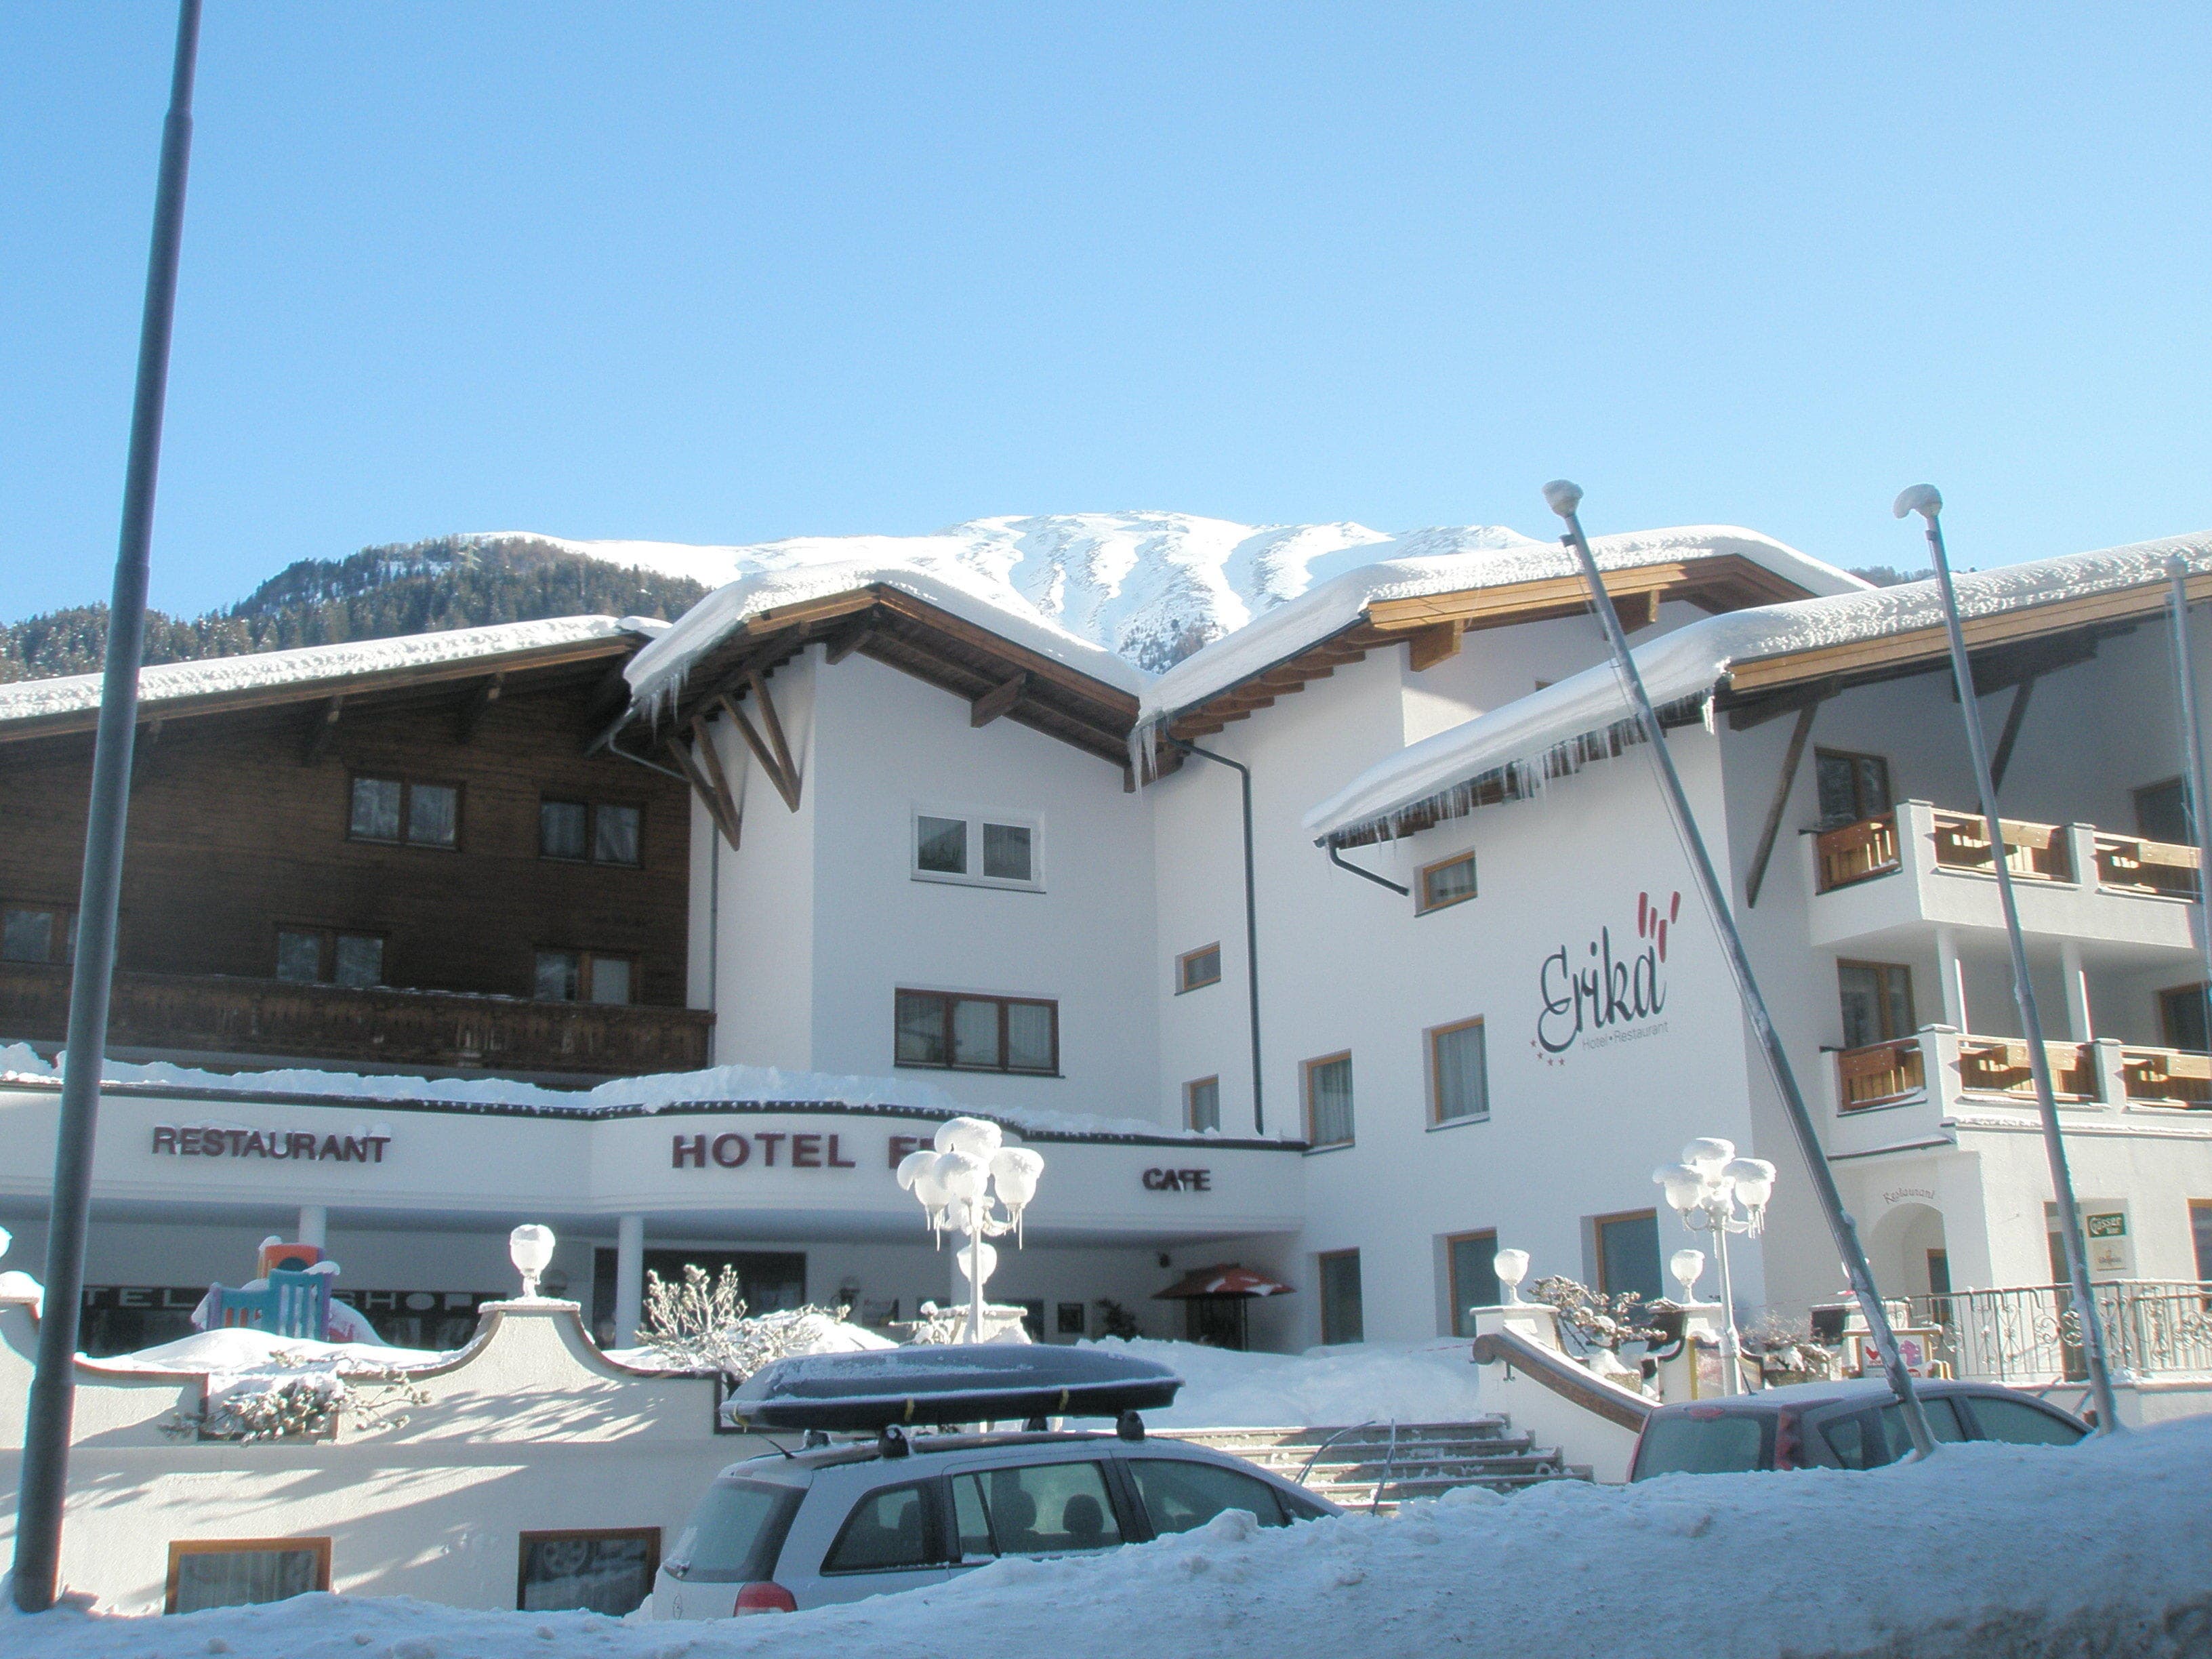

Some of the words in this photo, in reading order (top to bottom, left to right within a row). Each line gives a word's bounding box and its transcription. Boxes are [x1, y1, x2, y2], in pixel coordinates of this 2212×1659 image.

[152, 1126, 392, 1163] RESTAURANT
[672, 1132, 856, 1168] HOTEL
[1142, 1167, 1212, 1191] CAFE
